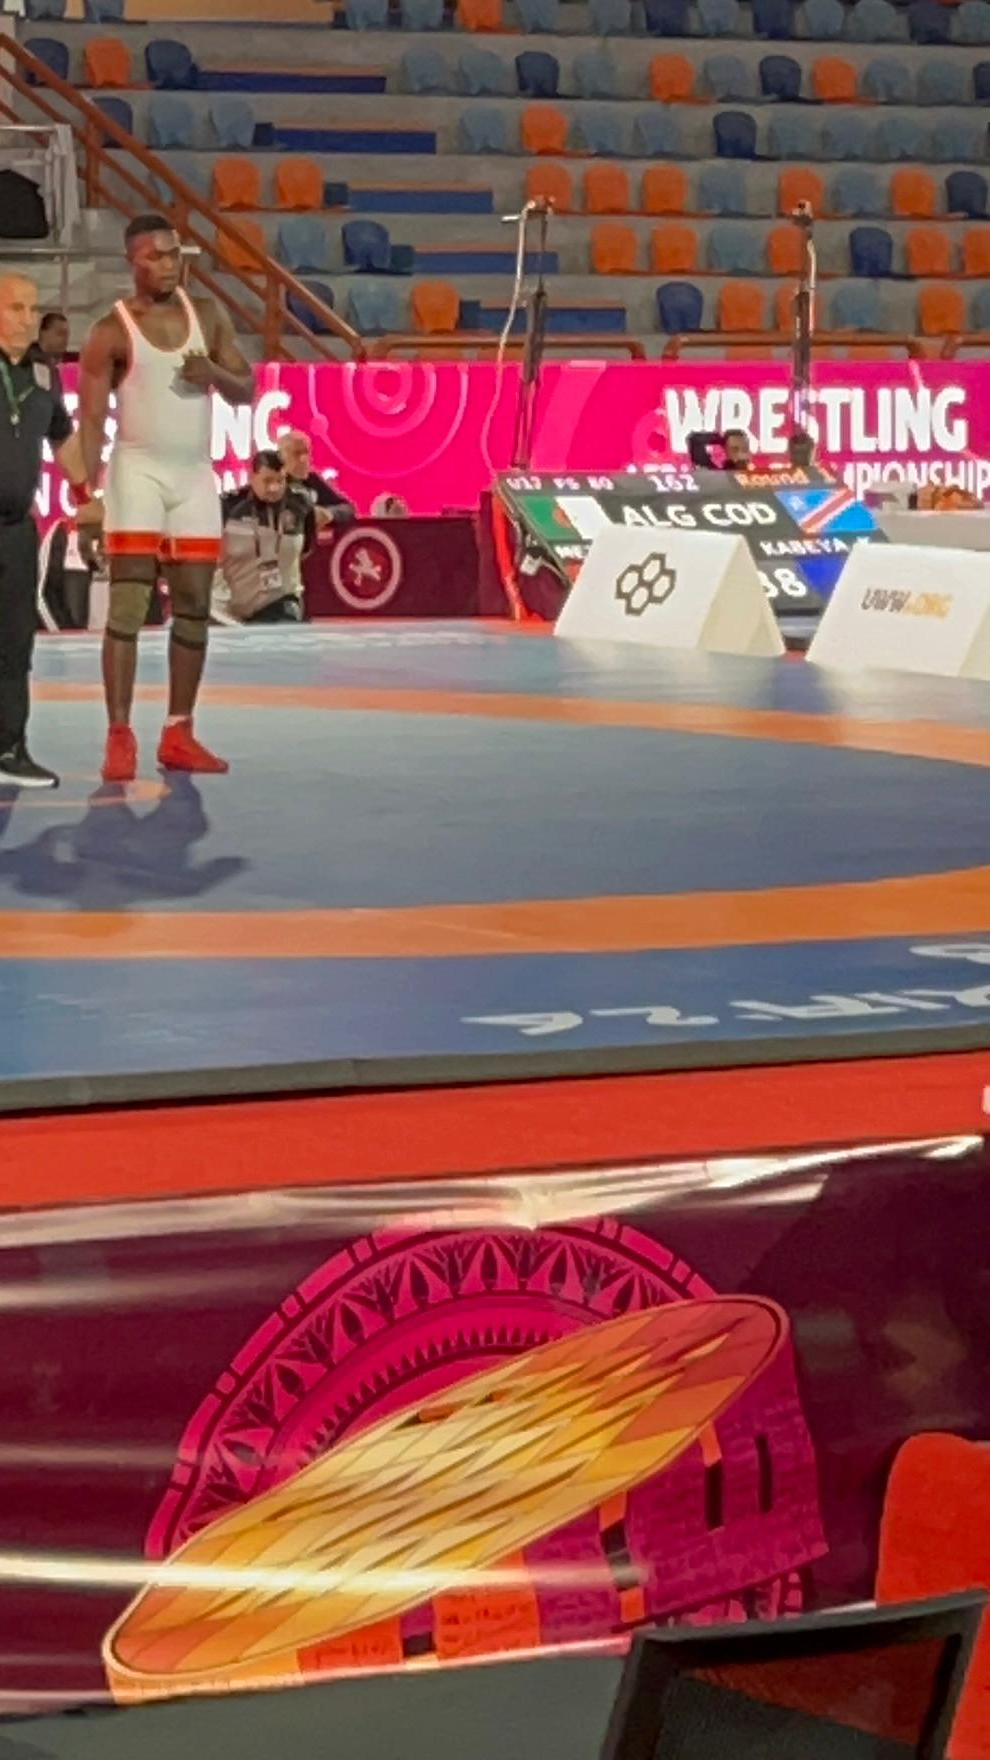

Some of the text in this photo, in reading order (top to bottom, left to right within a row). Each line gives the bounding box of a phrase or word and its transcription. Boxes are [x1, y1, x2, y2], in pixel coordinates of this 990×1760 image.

[647, 472, 700, 492] 162
[734, 467, 810, 488] Round
[621, 502, 777, 527] ALG COD
